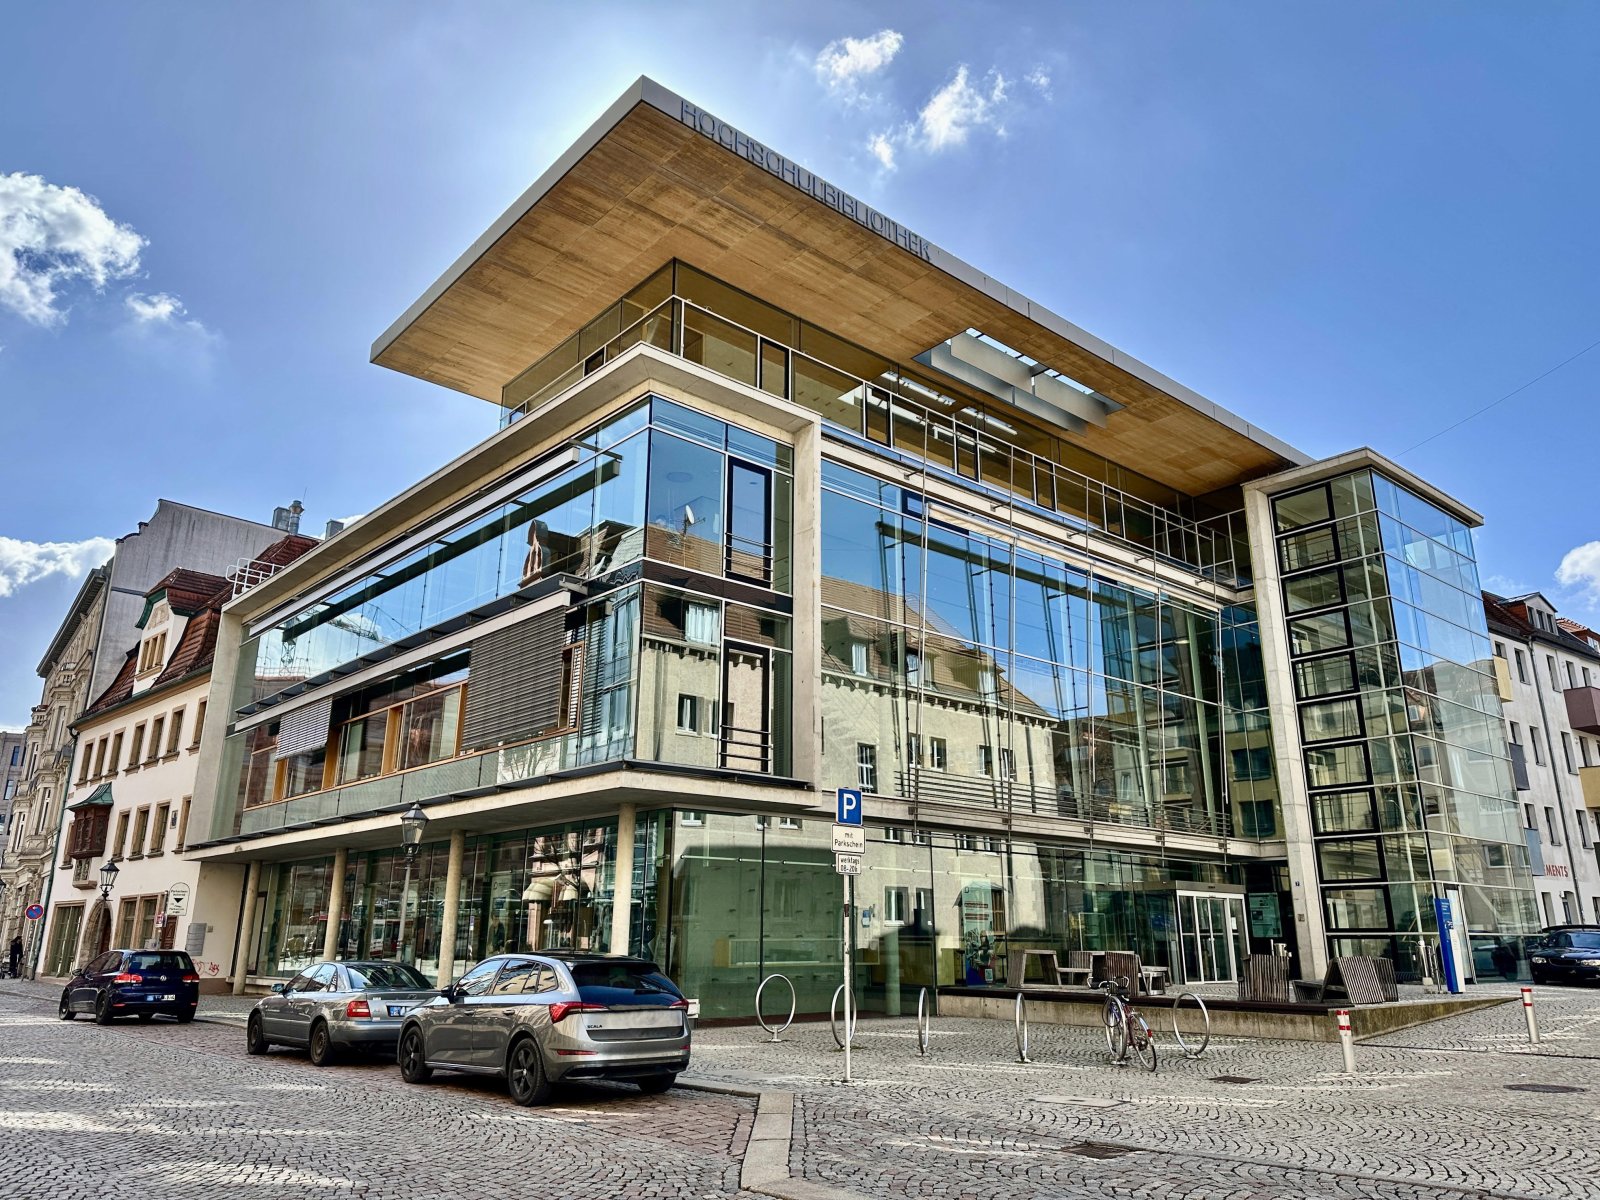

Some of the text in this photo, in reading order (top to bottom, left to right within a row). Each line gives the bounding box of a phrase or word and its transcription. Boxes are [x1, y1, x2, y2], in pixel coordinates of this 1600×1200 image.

[681, 100, 931, 260] HOCHSCHULBIBLIOTHEK
[843, 793, 856, 819] P
[834, 839, 863, 848] Parkschein
[1544, 864, 1568, 877] MENTS
